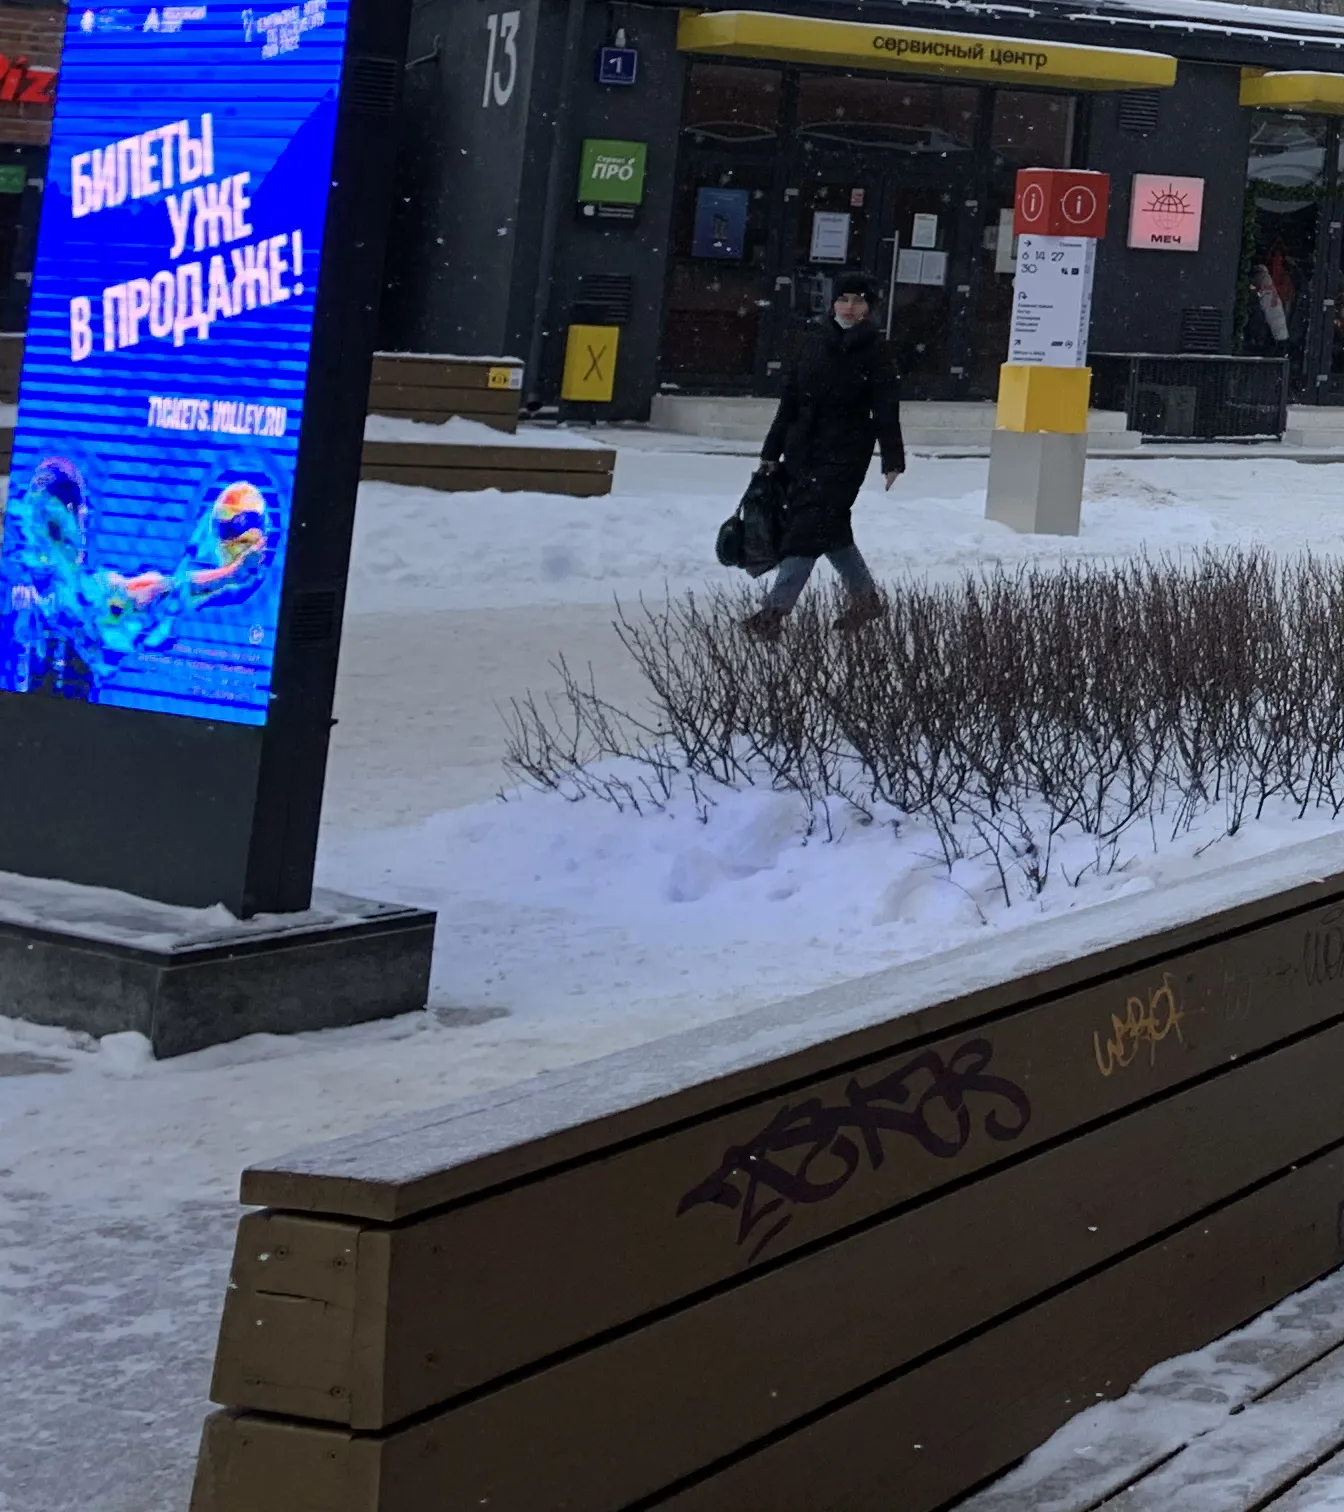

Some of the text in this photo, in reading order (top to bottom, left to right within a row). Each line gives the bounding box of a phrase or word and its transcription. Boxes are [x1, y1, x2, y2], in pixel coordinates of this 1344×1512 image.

[482, 10, 520, 107] 13
[609, 56, 622, 73] 1
[873, 35, 1048, 70] сервисный центр
[71, 112, 214, 218] БИЛЕТЫ
[165, 171, 252, 260] УЖЕ
[70, 229, 303, 362] В ПРОДАЖЕ!
[148, 396, 287, 438] TICKETS.VOLLEY.RU
